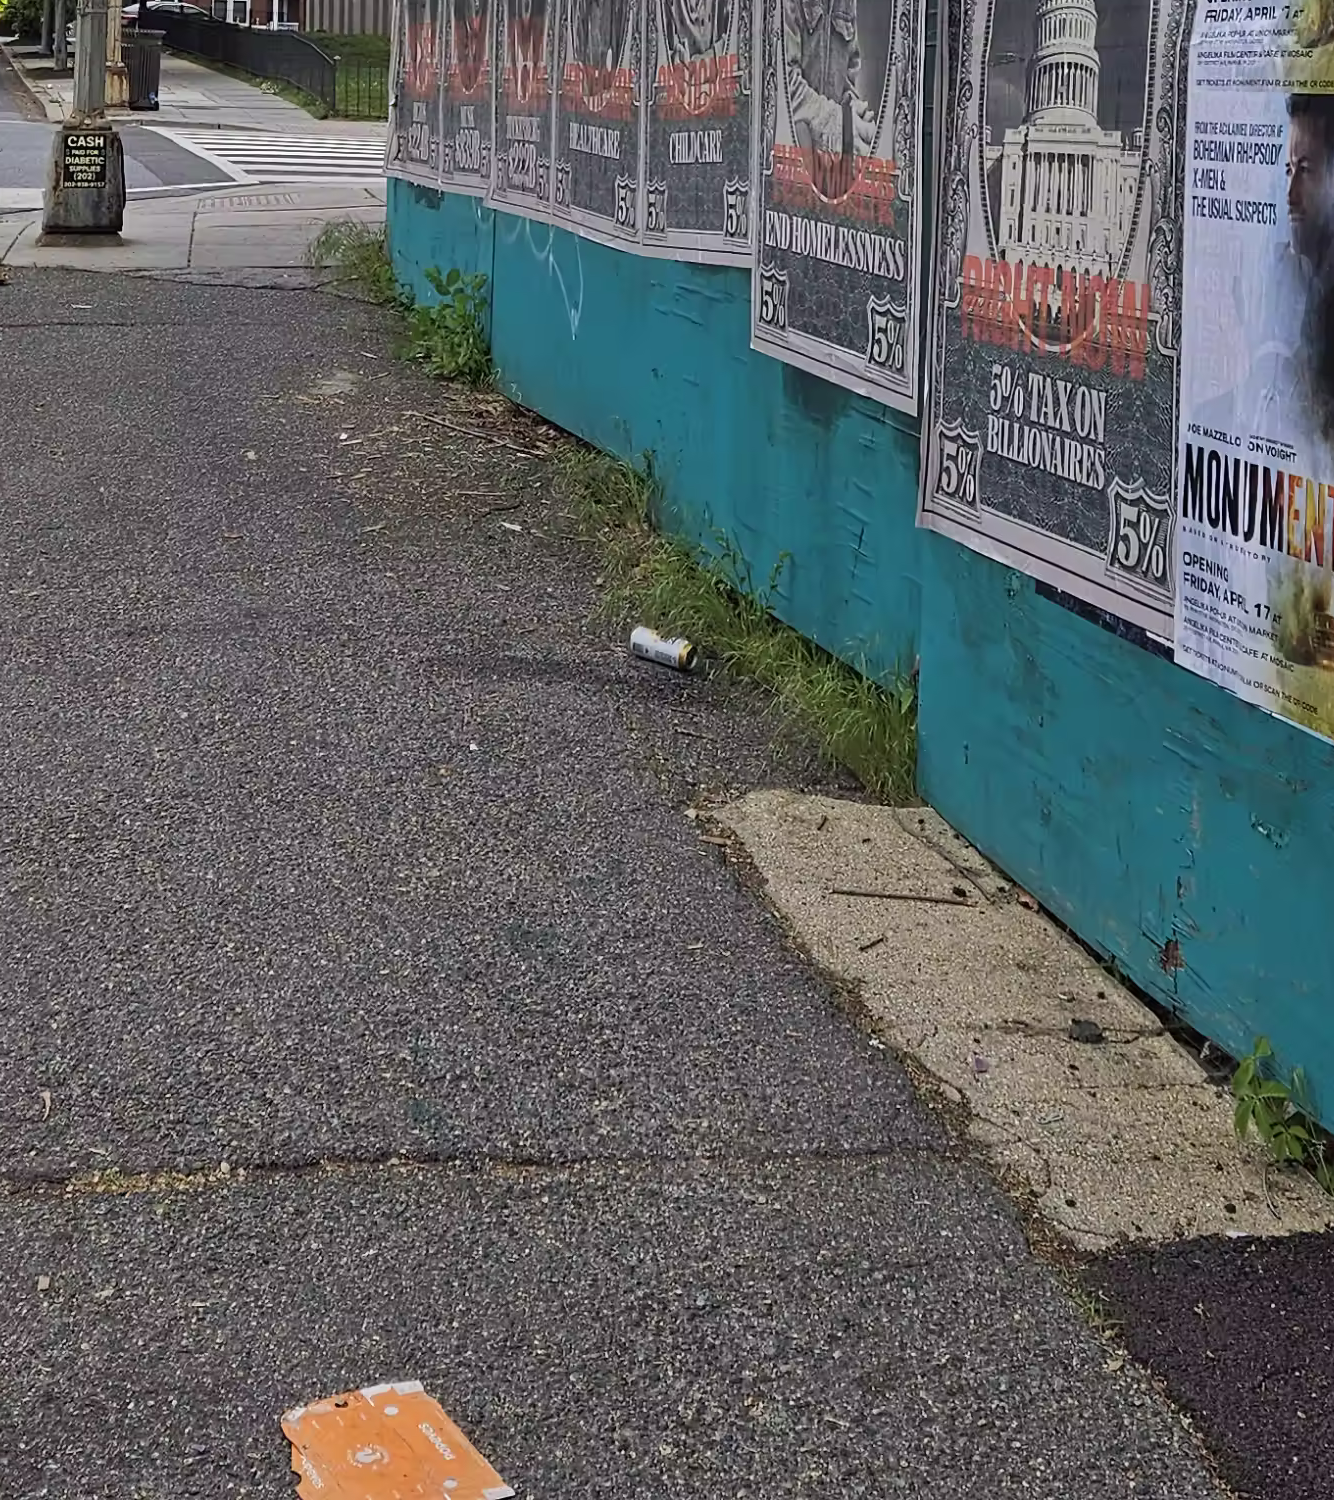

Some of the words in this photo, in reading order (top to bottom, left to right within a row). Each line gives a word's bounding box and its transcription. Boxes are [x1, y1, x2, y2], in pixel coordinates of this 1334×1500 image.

[68, 136, 103, 147] CASH
[569, 122, 620, 160] HEALTHCARE
[669, 129, 723, 164] CHILDCARE
[727, 194, 748, 236] 5%
[765, 210, 791, 252] END
[791, 214, 905, 282] HOMELESSNESS
[761, 278, 785, 327] 5%
[873, 316, 903, 370] 5%
[989, 363, 1025, 418] 5%
[1027, 372, 1073, 432] TAX
[1073, 388, 1107, 444] ON
[940, 442, 975, 502] 5%
[987, 414, 1107, 492] BILLIONAIRES
[1117, 504, 1165, 578] 5%
